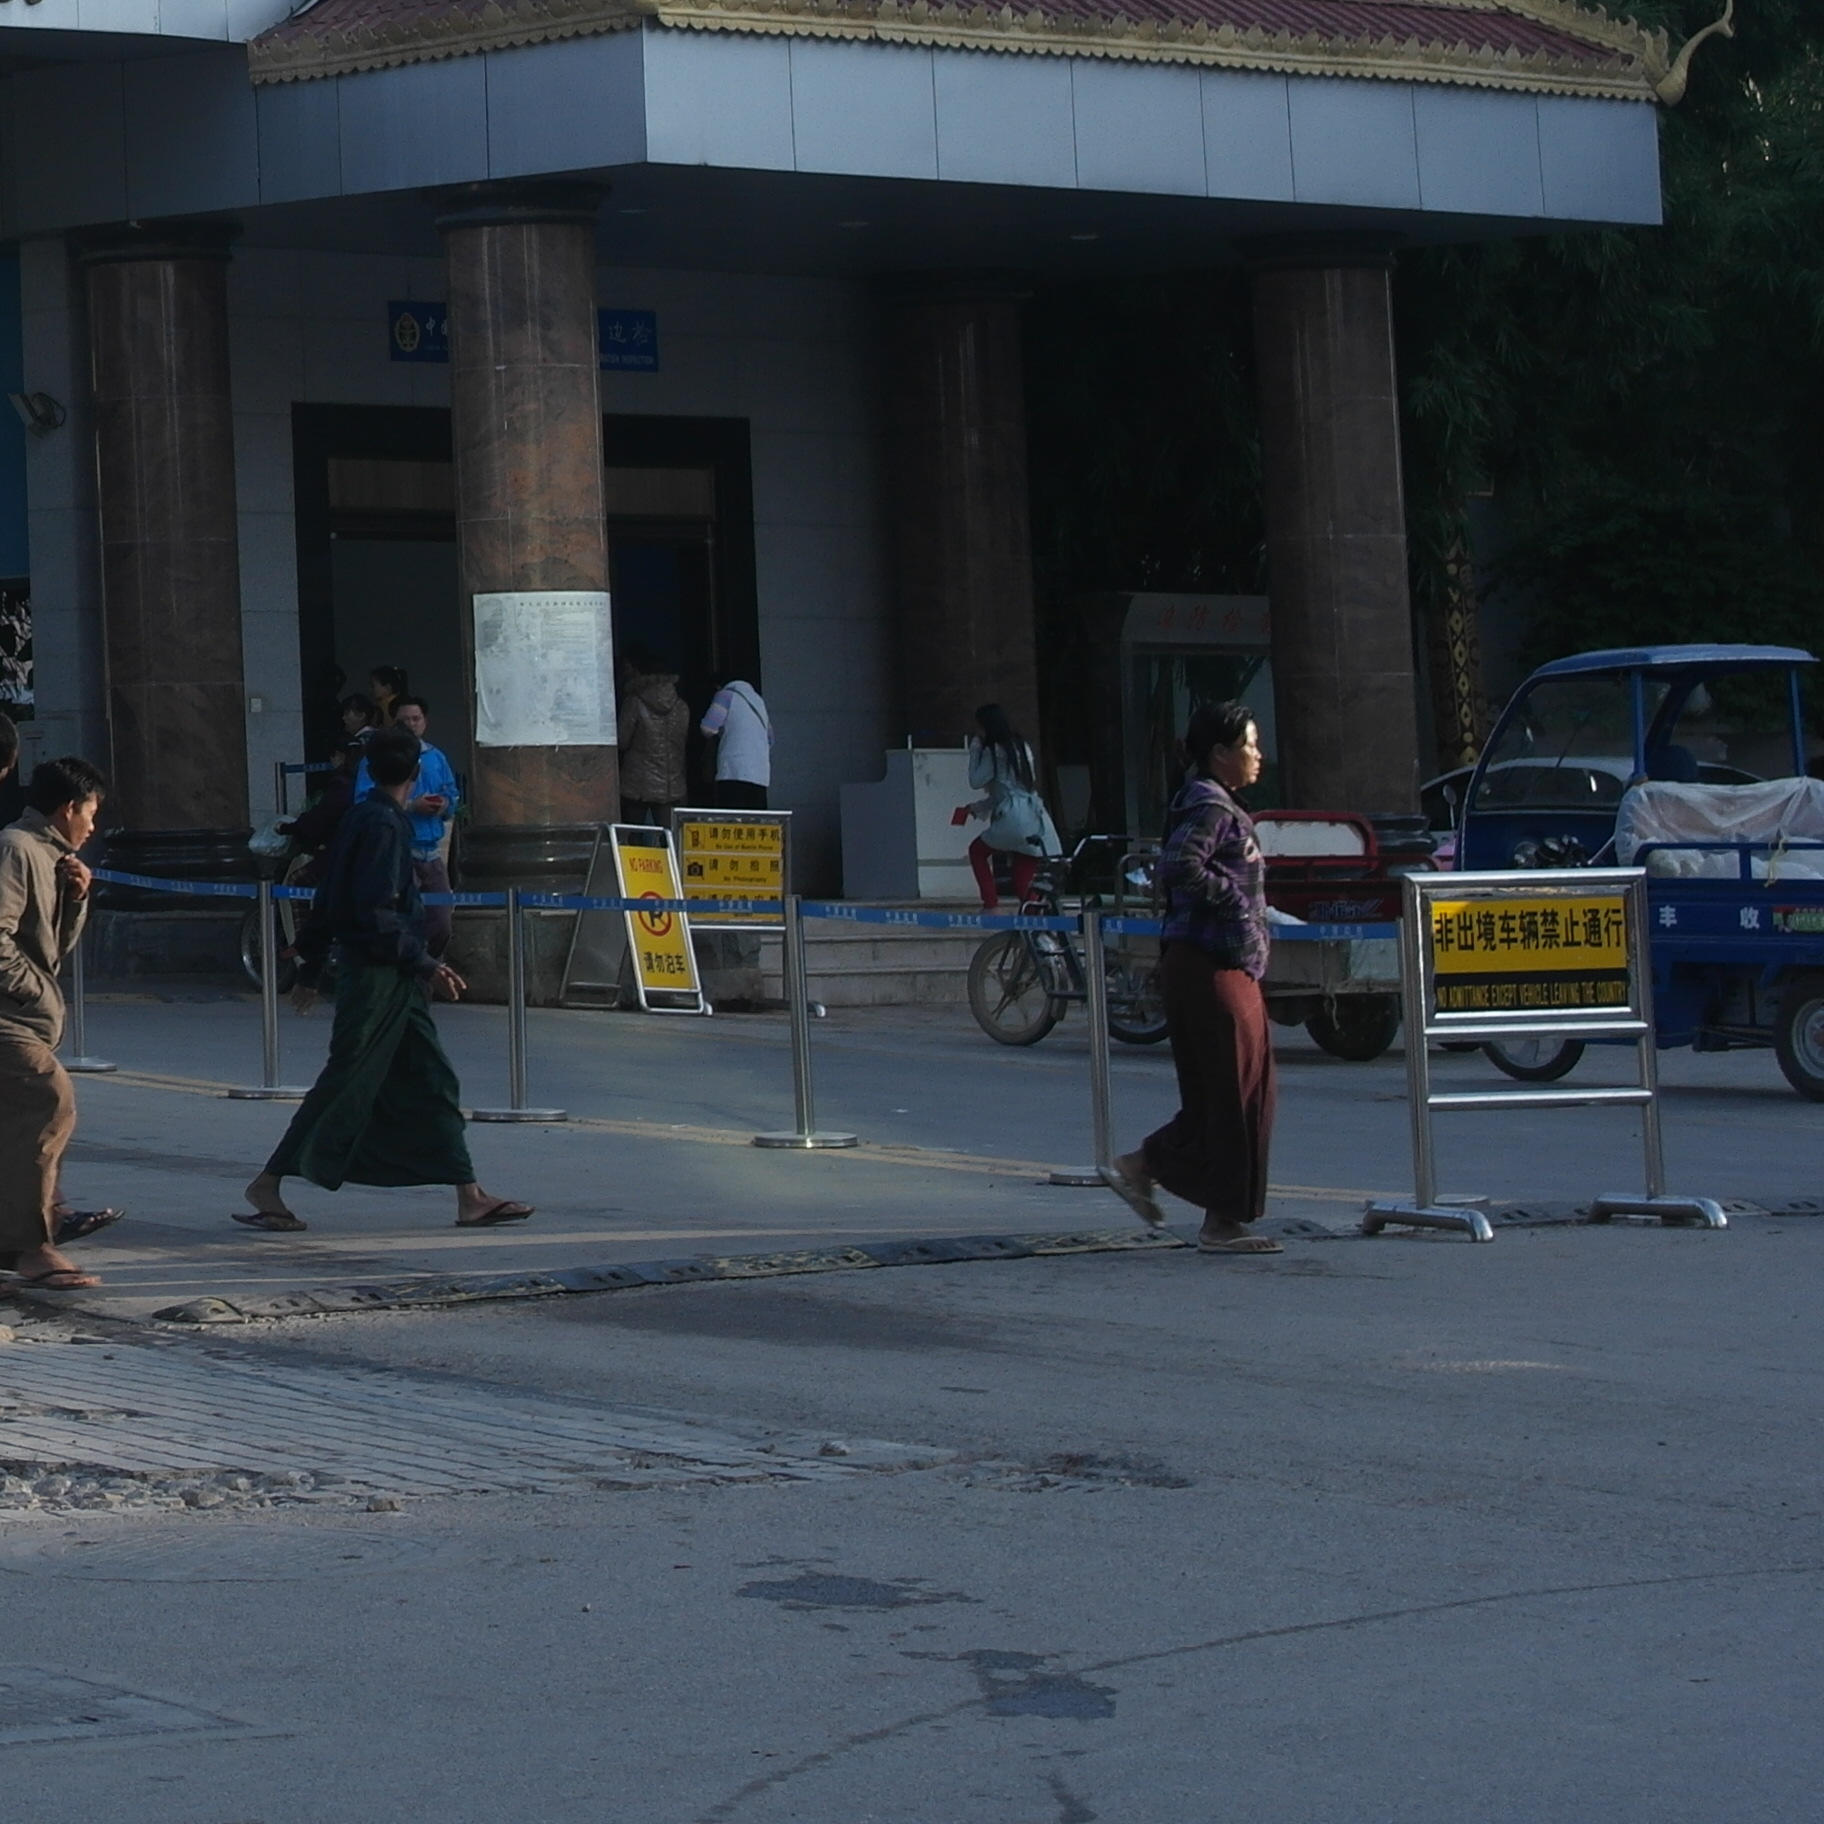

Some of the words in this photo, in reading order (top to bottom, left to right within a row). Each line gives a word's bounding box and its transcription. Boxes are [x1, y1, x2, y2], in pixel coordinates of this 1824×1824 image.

[709, 827, 780, 842] 请勿使用手机
[709, 860, 780, 873] 请勿拍照
[1659, 904, 1760, 930] 丰收
[1435, 908, 1623, 952] 非出境车辆禁止通行
[643, 951, 686, 975] 请勿泊车
[1436, 986, 1447, 1008] NO
[1491, 984, 1517, 1007] EXCEPT
[1519, 983, 1549, 1006] VEHICLE
[1551, 983, 1580, 1005] LEAVING
[1581, 982, 1595, 1004] THE
[1597, 980, 1625, 1003] COUNTRY
